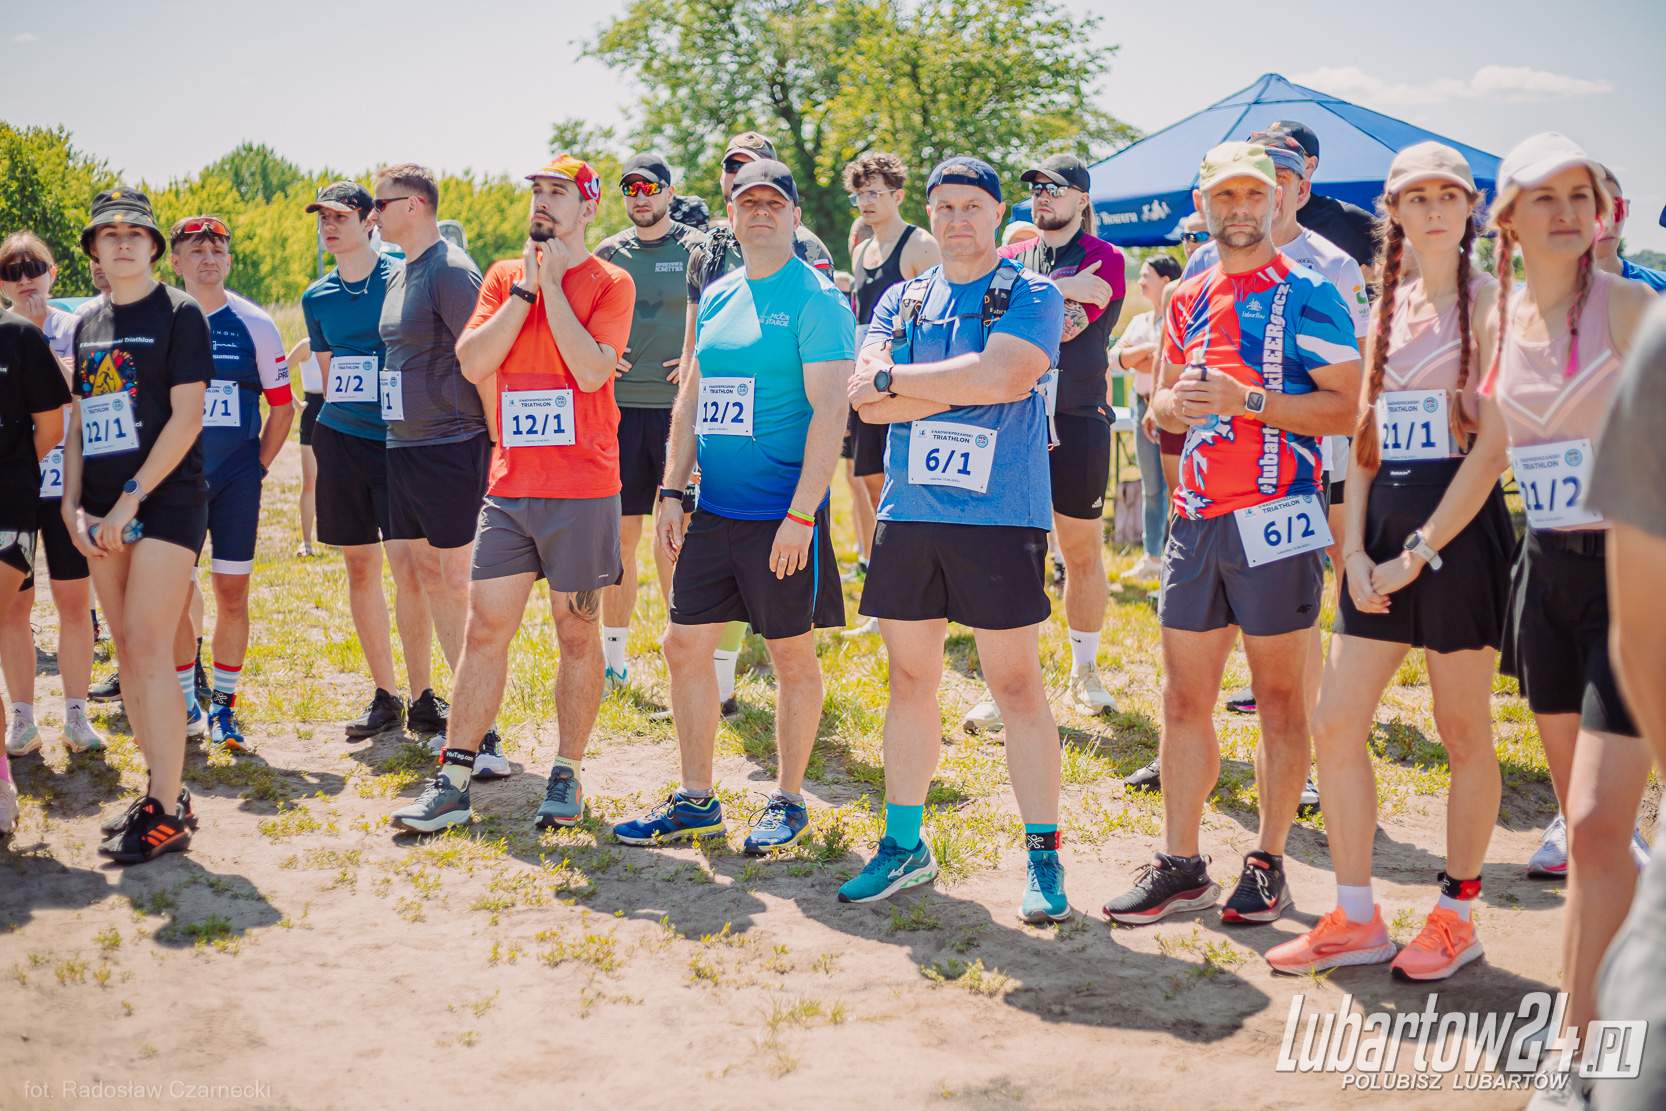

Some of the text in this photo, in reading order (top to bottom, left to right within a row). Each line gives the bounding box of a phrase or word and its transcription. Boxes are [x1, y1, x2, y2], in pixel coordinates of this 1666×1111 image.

[335, 375, 364, 393] 2/2
[1257, 282, 1291, 495] #lubartkiBEERgacz
[702, 401, 744, 424] 12/2
[512, 413, 565, 436] 12/1
[1383, 421, 1437, 450] 21/1
[933, 434, 970, 444] TRIATHLON
[925, 447, 971, 476] 6/1
[1262, 499, 1300, 513] TRIATHLON
[1264, 512, 1315, 546] 6/2
